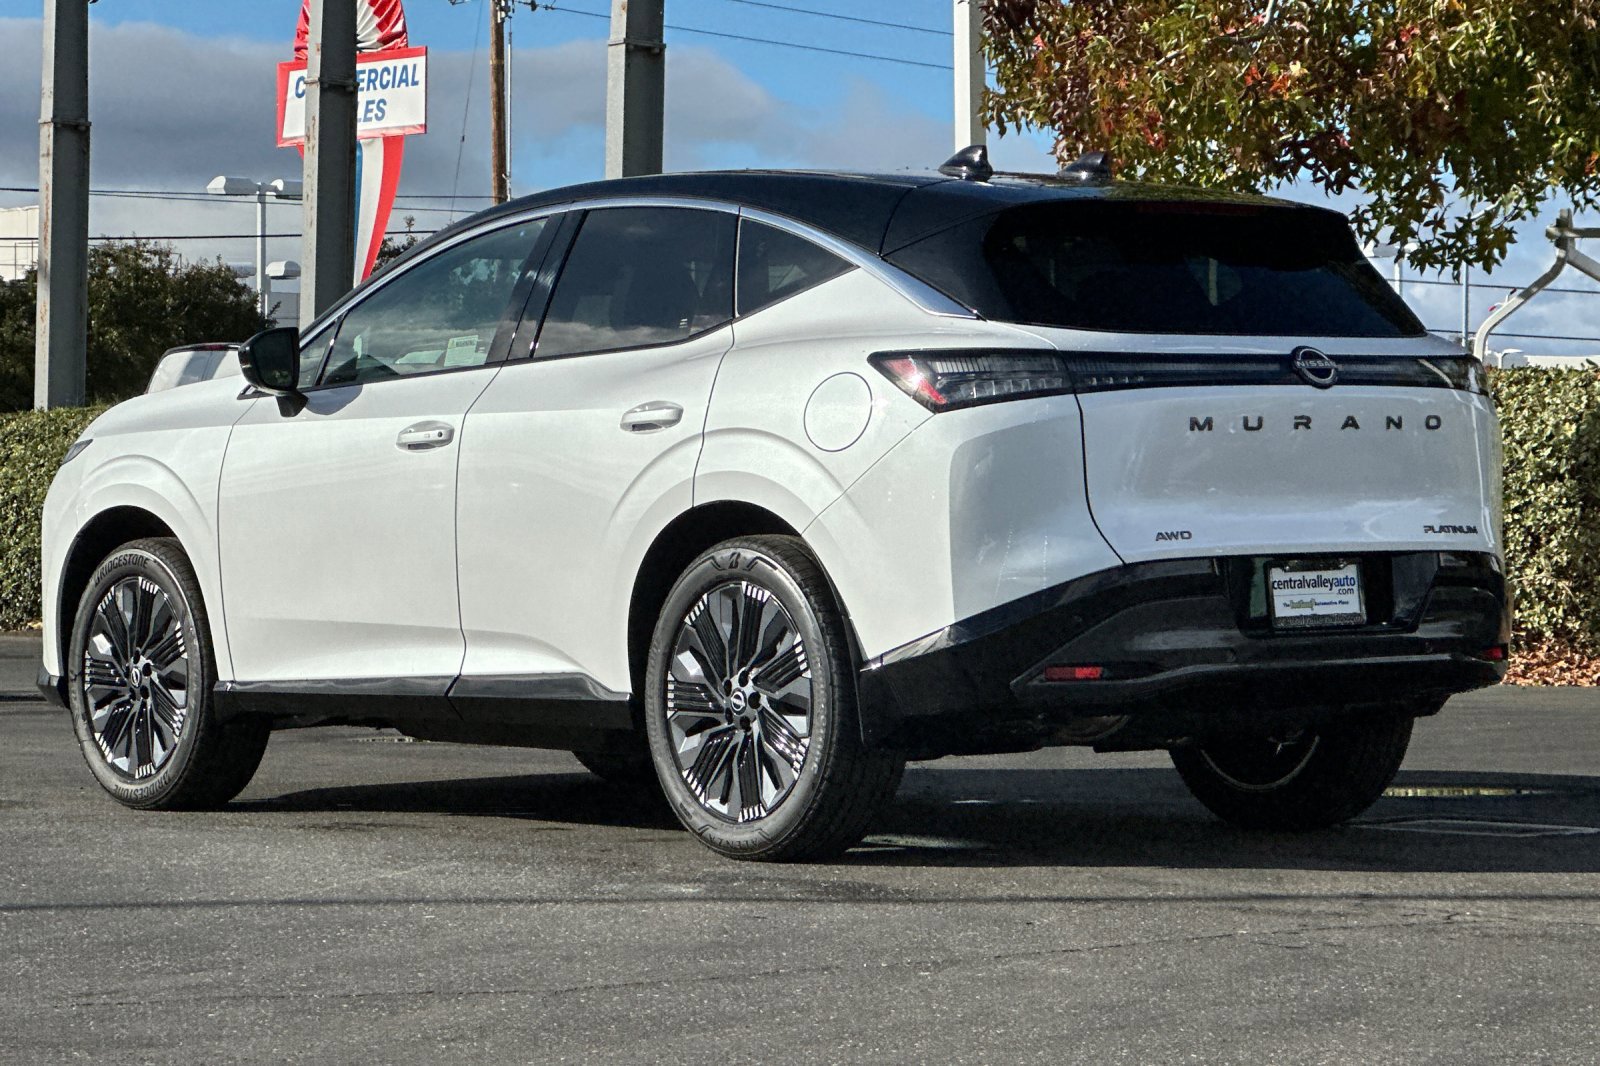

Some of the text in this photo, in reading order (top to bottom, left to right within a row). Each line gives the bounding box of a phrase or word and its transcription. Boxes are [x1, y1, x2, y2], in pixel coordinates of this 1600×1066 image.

[295, 64, 419, 98] CERCIAL
[1296, 360, 1337, 368] NISSAN
[1188, 414, 1442, 431] MURANO
[1155, 530, 1193, 541] AWD
[1423, 525, 1478, 534] PLATINUM
[94, 553, 148, 588] BRIDGESTONE
[1272, 575, 1356, 591] centralvalleyauto
[1336, 587, 1355, 595] .com
